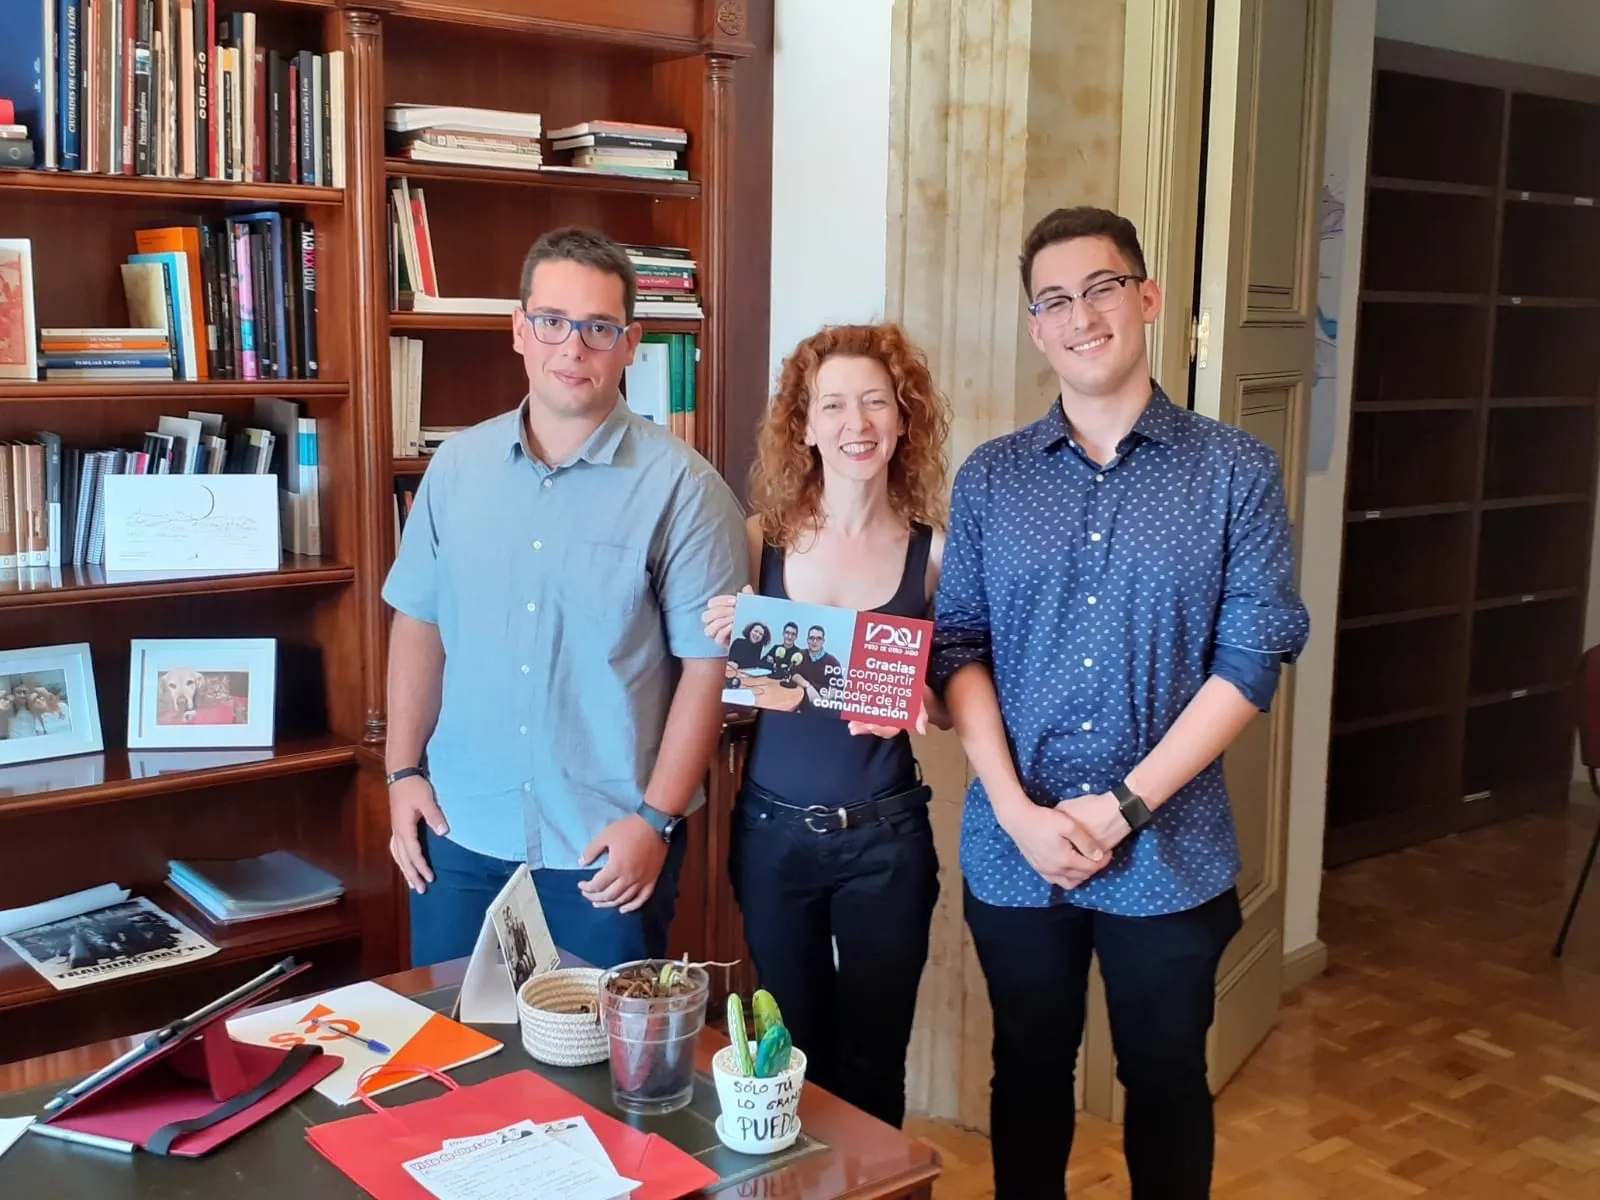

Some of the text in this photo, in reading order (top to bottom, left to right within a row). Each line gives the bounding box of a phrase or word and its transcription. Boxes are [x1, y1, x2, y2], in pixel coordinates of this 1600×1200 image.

[198, 52, 207, 119] OVIEDO
[824, 664, 914, 686] por compartir
[866, 658, 916, 674] Gracias
[820, 686, 906, 708] el poder de la
[829, 677, 912, 698] con nosotros
[813, 698, 909, 720] comunicación
[734, 1076, 793, 1096] SÓLO TÚ
[738, 1099, 755, 1110] LO
